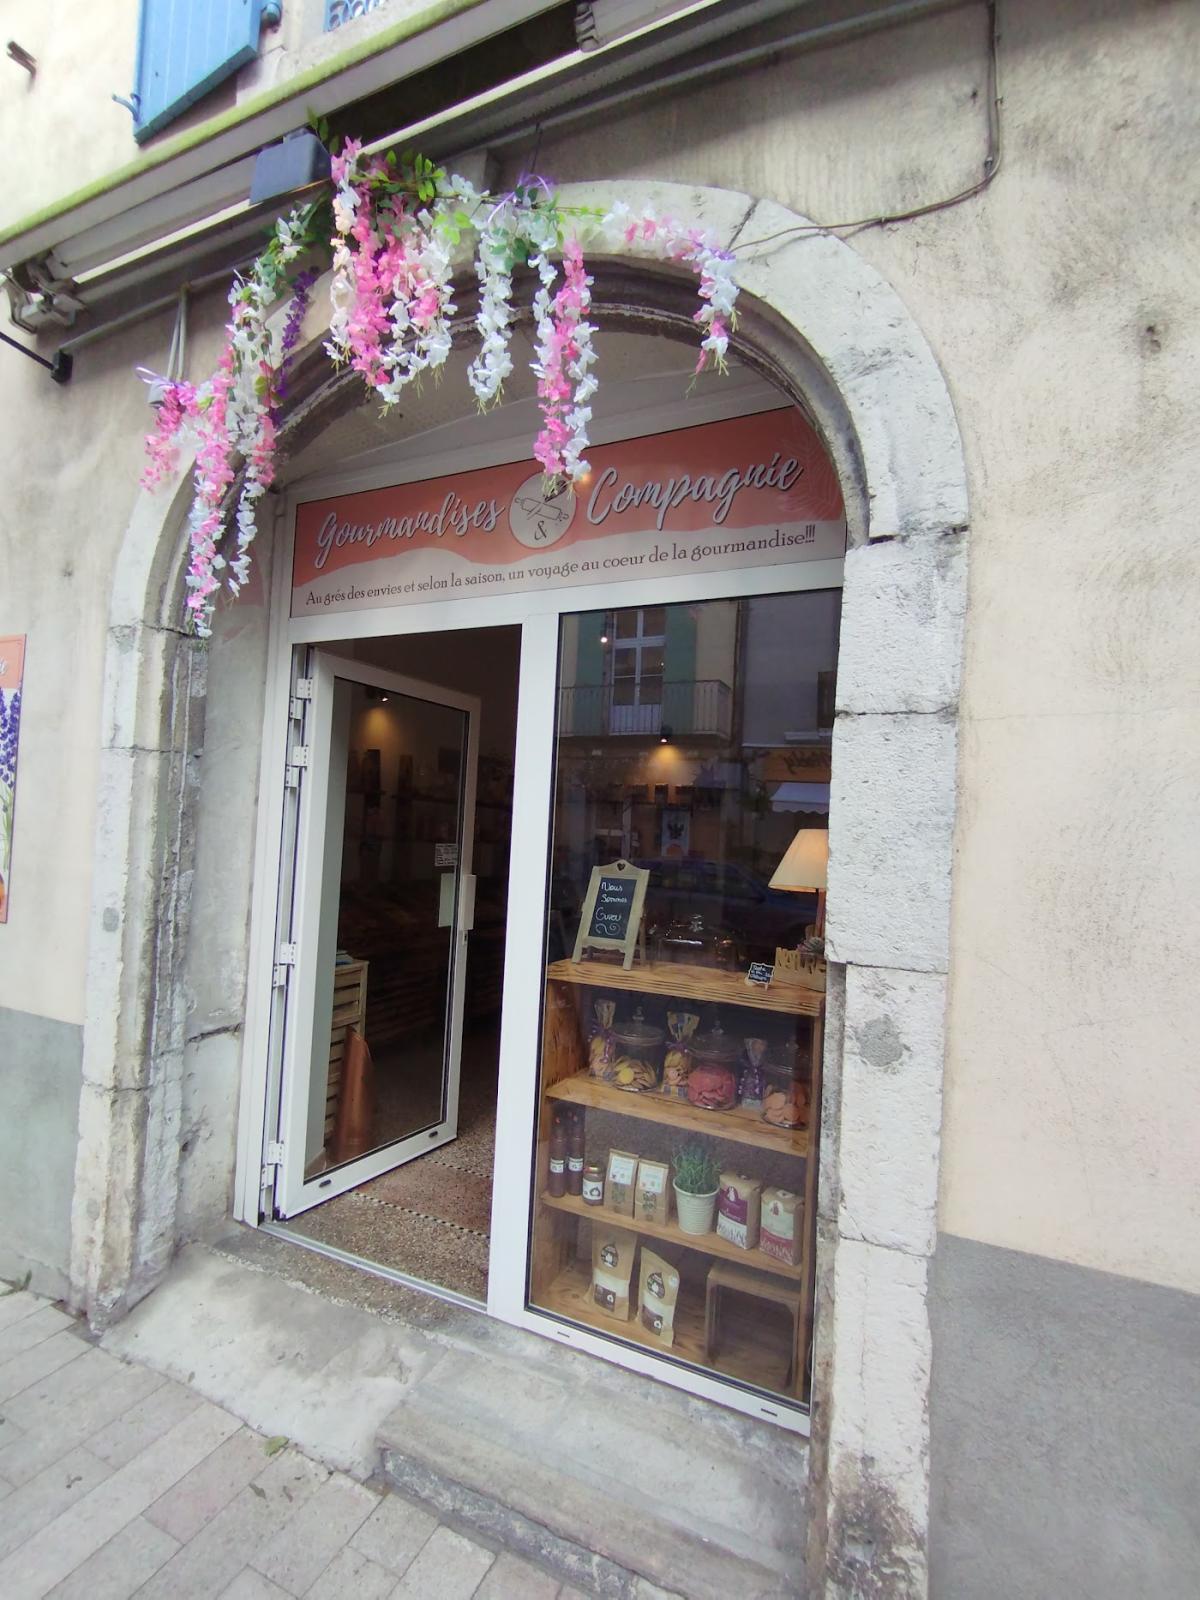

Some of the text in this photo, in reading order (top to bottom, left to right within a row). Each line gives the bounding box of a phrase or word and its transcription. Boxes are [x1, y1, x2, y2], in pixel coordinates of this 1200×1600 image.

[314, 491, 505, 569] Gourmandises
[587, 452, 804, 531] Compagnie
[305, 591, 322, 606] Au
[347, 585, 365, 600] des
[367, 584, 402, 598] envies
[403, 580, 416, 593] et
[417, 575, 448, 590] selon
[450, 571, 462, 587] la
[464, 571, 506, 586] saison,
[508, 569, 524, 580] un
[528, 560, 579, 579] voyage
[581, 561, 599, 571] au
[602, 554, 646, 569] coeur
[648, 544, 669, 563] de
[672, 542, 687, 560] la
[691, 524, 816, 562] gourmandise!!!
